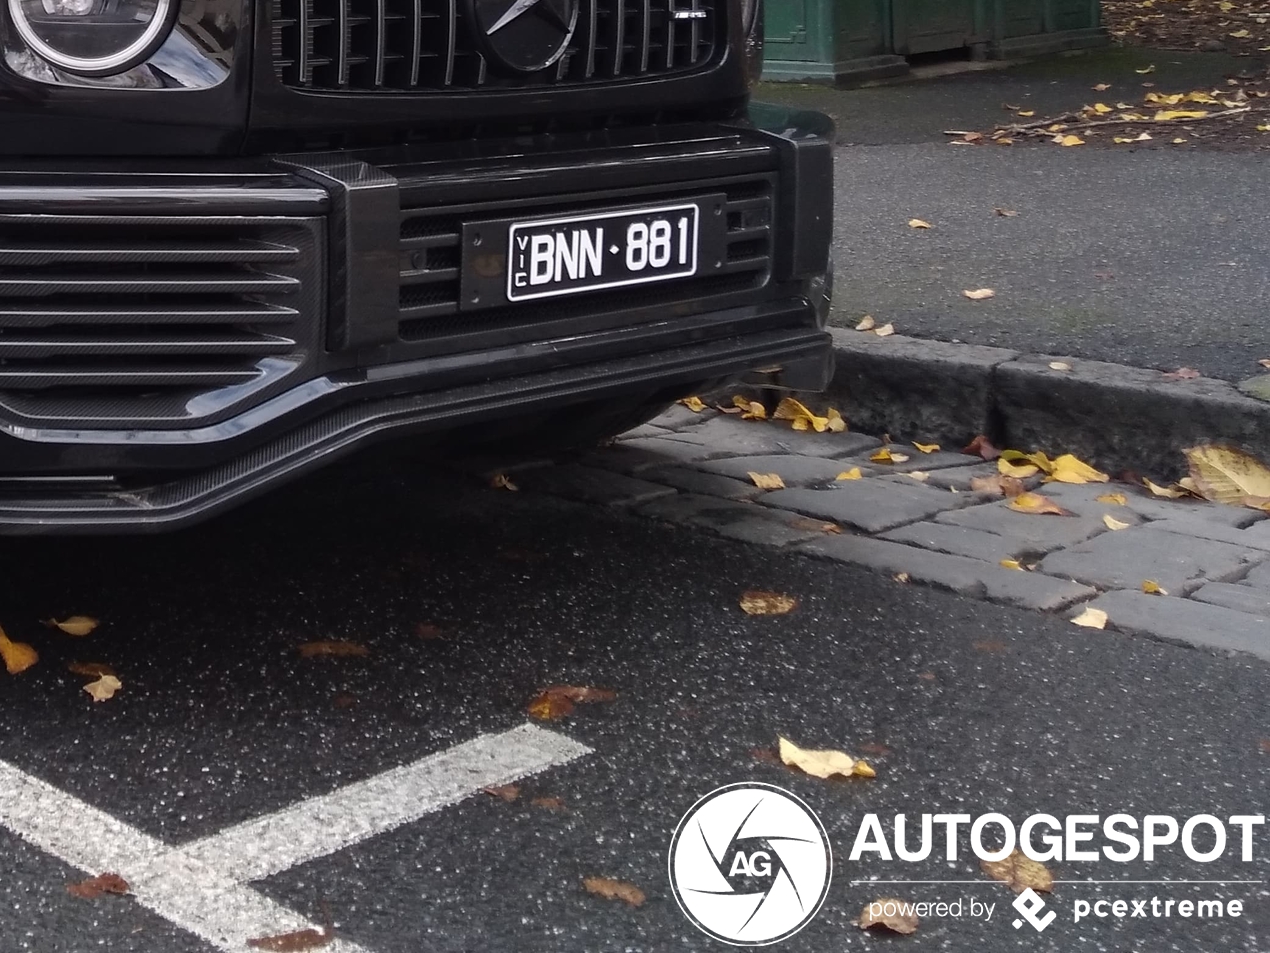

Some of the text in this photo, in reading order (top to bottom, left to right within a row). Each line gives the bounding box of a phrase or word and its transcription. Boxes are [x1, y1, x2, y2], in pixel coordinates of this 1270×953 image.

[515, 236, 528, 287] VIC
[530, 217, 688, 285] BNN 881
